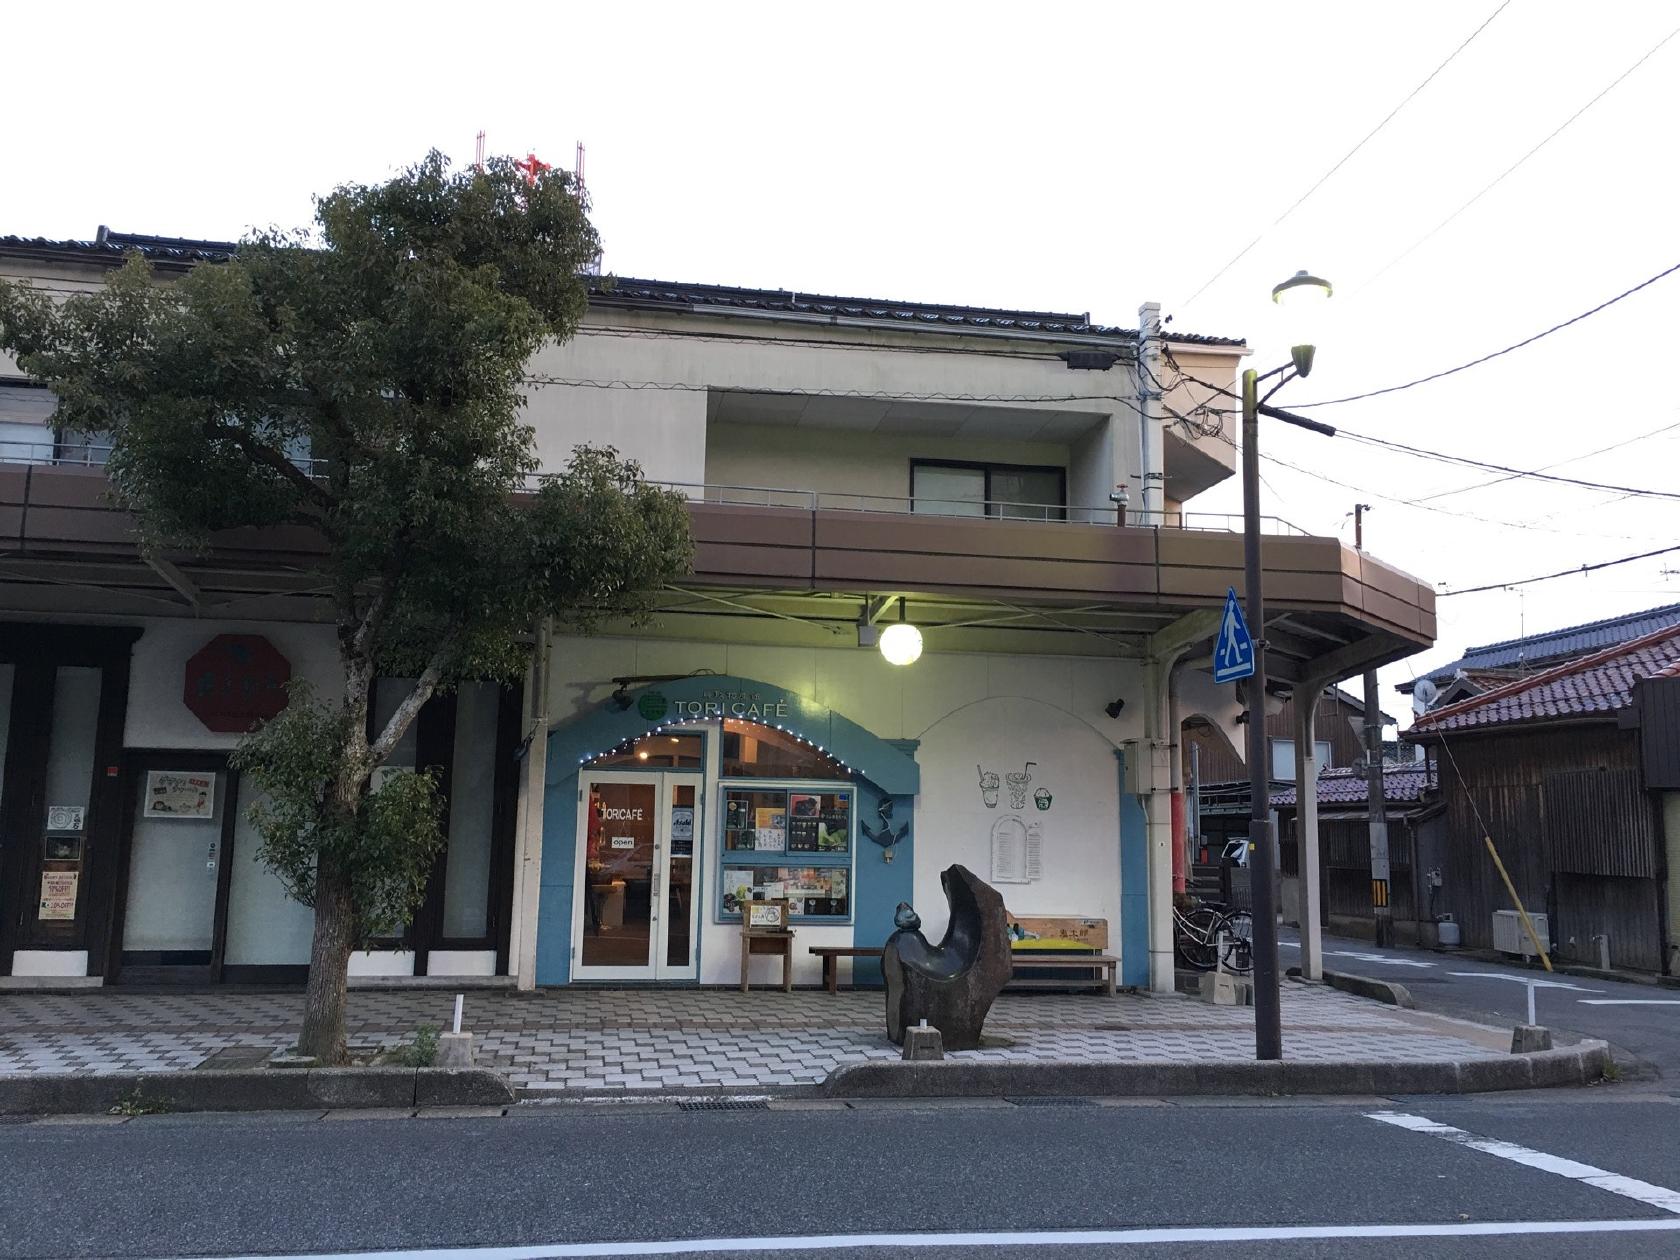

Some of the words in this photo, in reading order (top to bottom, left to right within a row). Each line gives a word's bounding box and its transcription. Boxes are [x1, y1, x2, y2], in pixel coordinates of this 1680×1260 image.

[674, 701, 725, 715] TORI
[731, 699, 788, 718] CAFÉ
[613, 839, 633, 847] open
